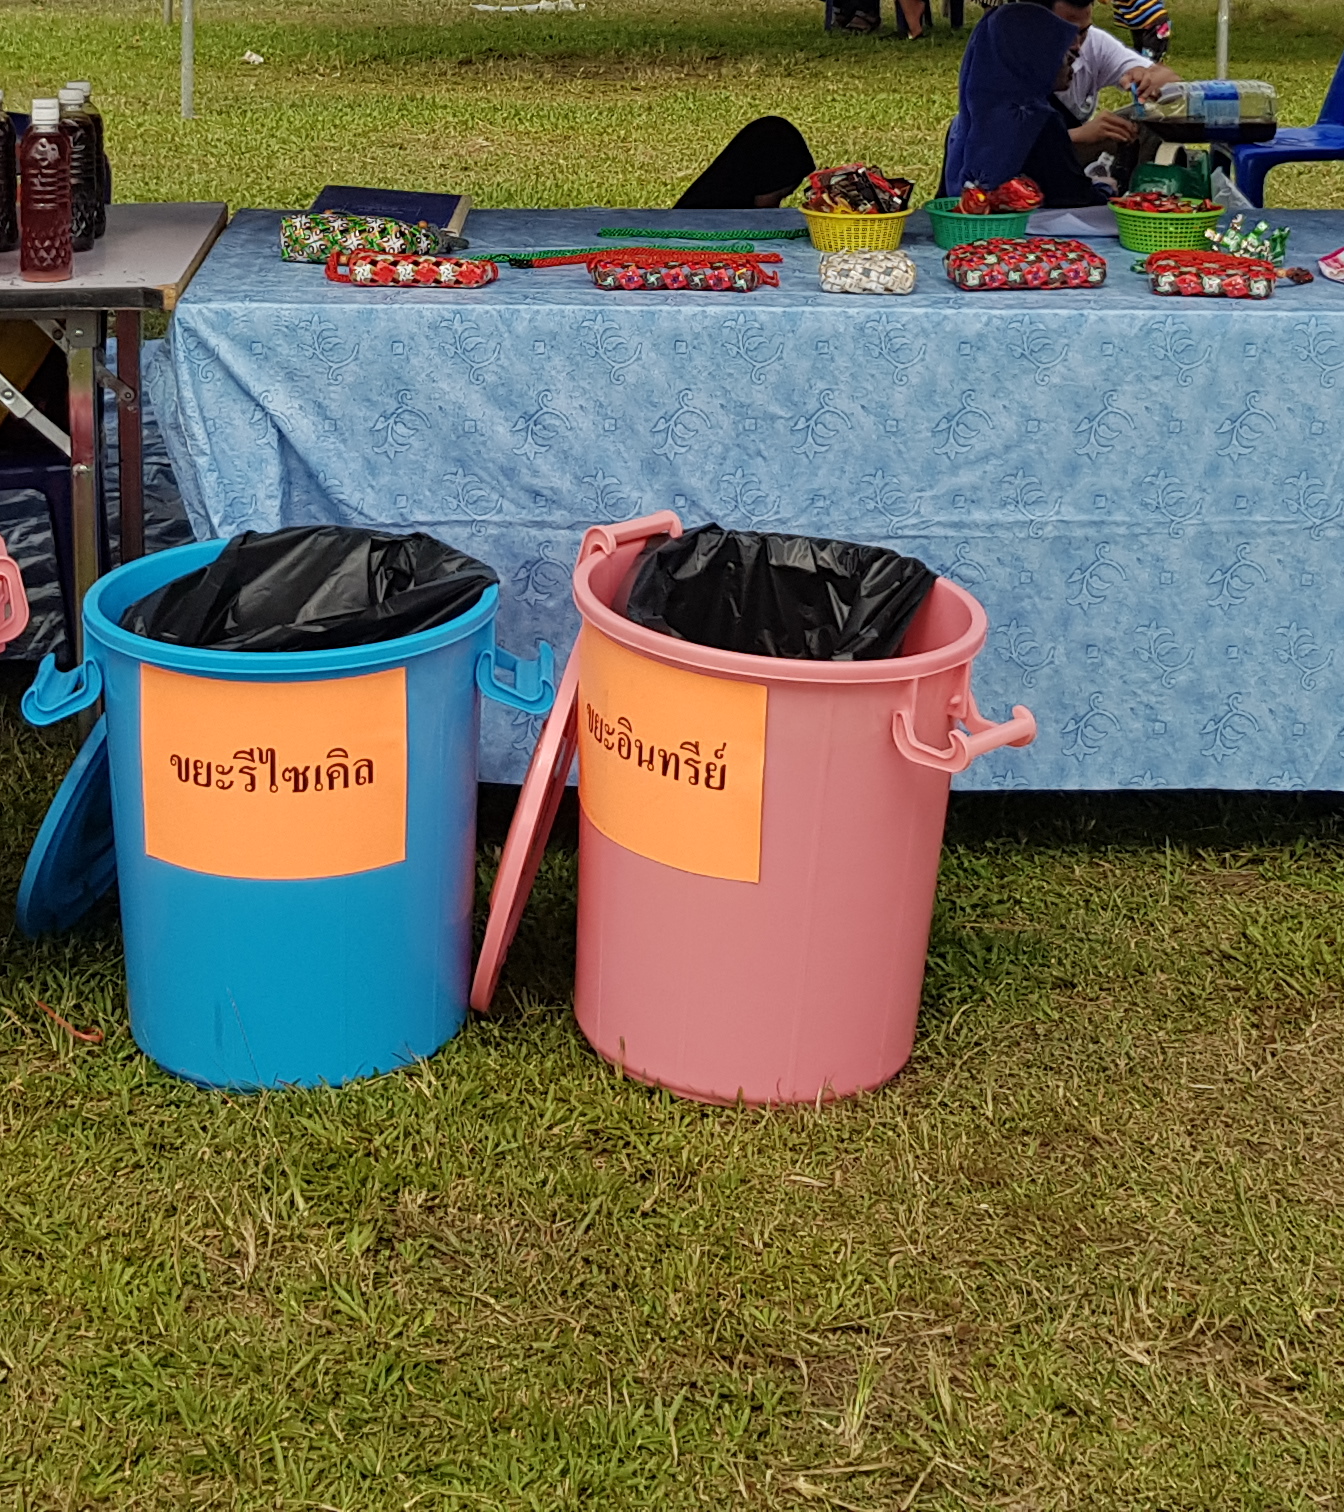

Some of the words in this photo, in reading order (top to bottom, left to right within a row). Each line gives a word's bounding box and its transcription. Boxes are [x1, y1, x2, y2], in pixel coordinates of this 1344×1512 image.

[170, 746, 376, 794] ขยะรีไซเคิล
[585, 699, 728, 793] ขยะอินทรีย์
